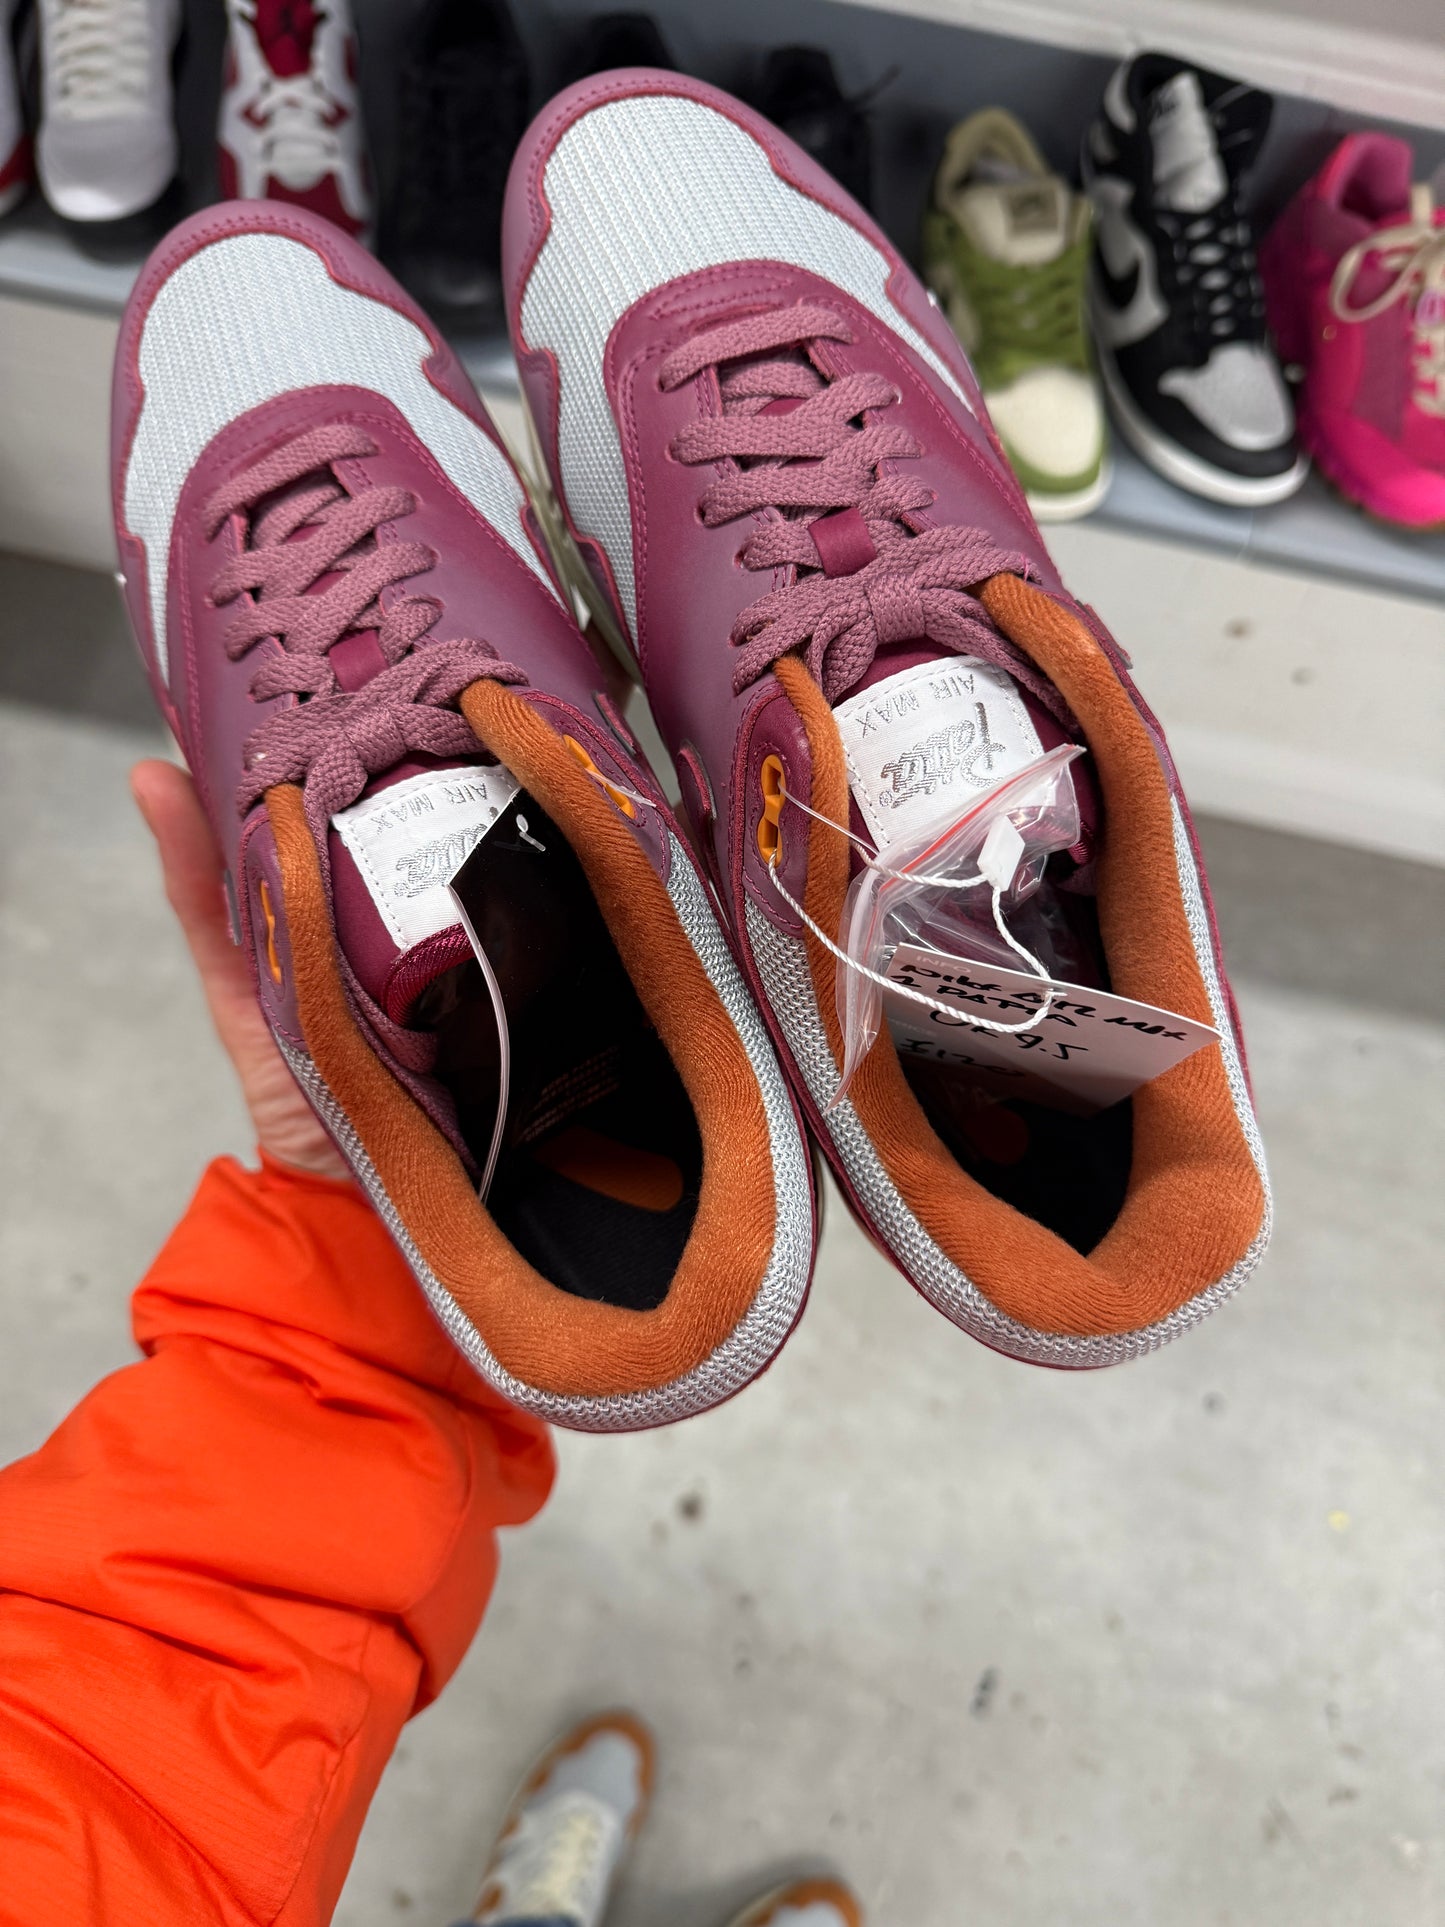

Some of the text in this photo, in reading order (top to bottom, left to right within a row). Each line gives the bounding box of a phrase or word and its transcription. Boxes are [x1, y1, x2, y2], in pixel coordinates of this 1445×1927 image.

[855, 673, 975, 738] AIR MAX
[371, 782, 487, 834] AIR MAX
[916, 955, 971, 974] INFO
[1009, 992, 1096, 1018] AR
[1014, 1033, 1088, 1060] 9.5
